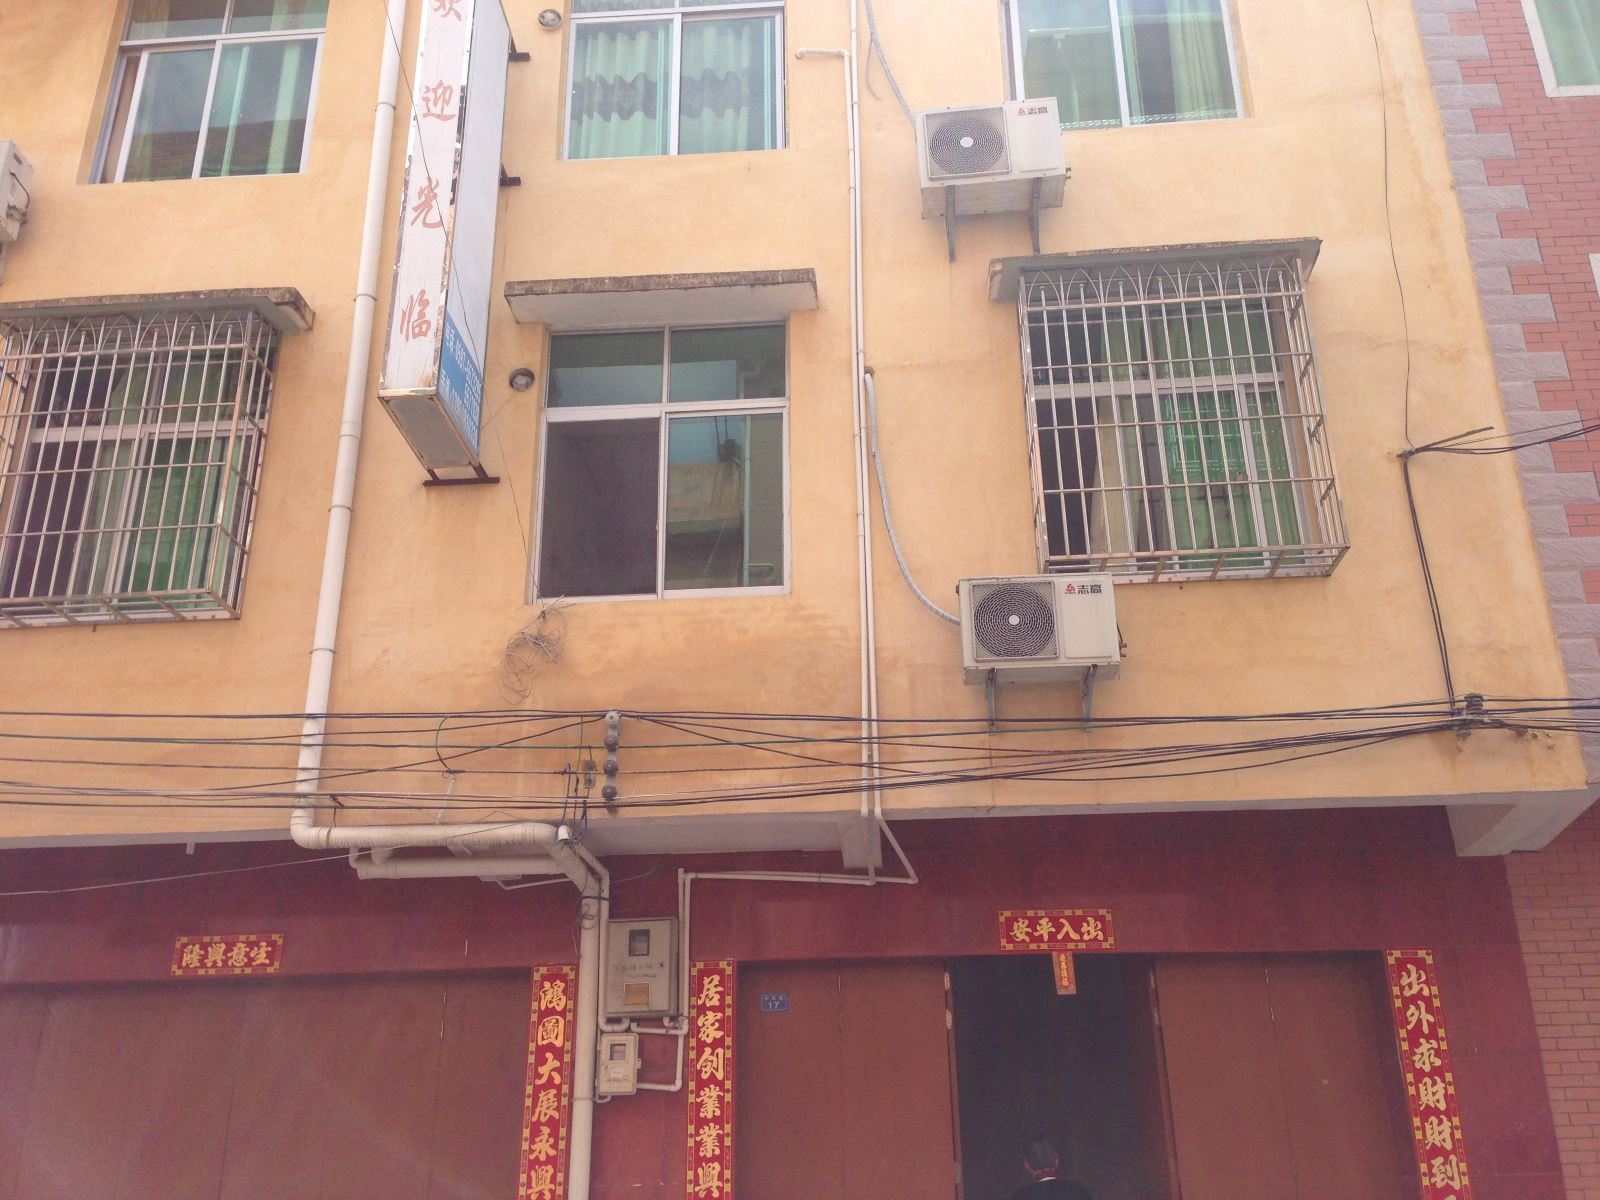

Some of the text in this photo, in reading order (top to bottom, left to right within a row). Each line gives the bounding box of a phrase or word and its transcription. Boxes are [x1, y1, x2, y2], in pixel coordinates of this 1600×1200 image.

[1399, 963, 1461, 1200] 出外求財財到
